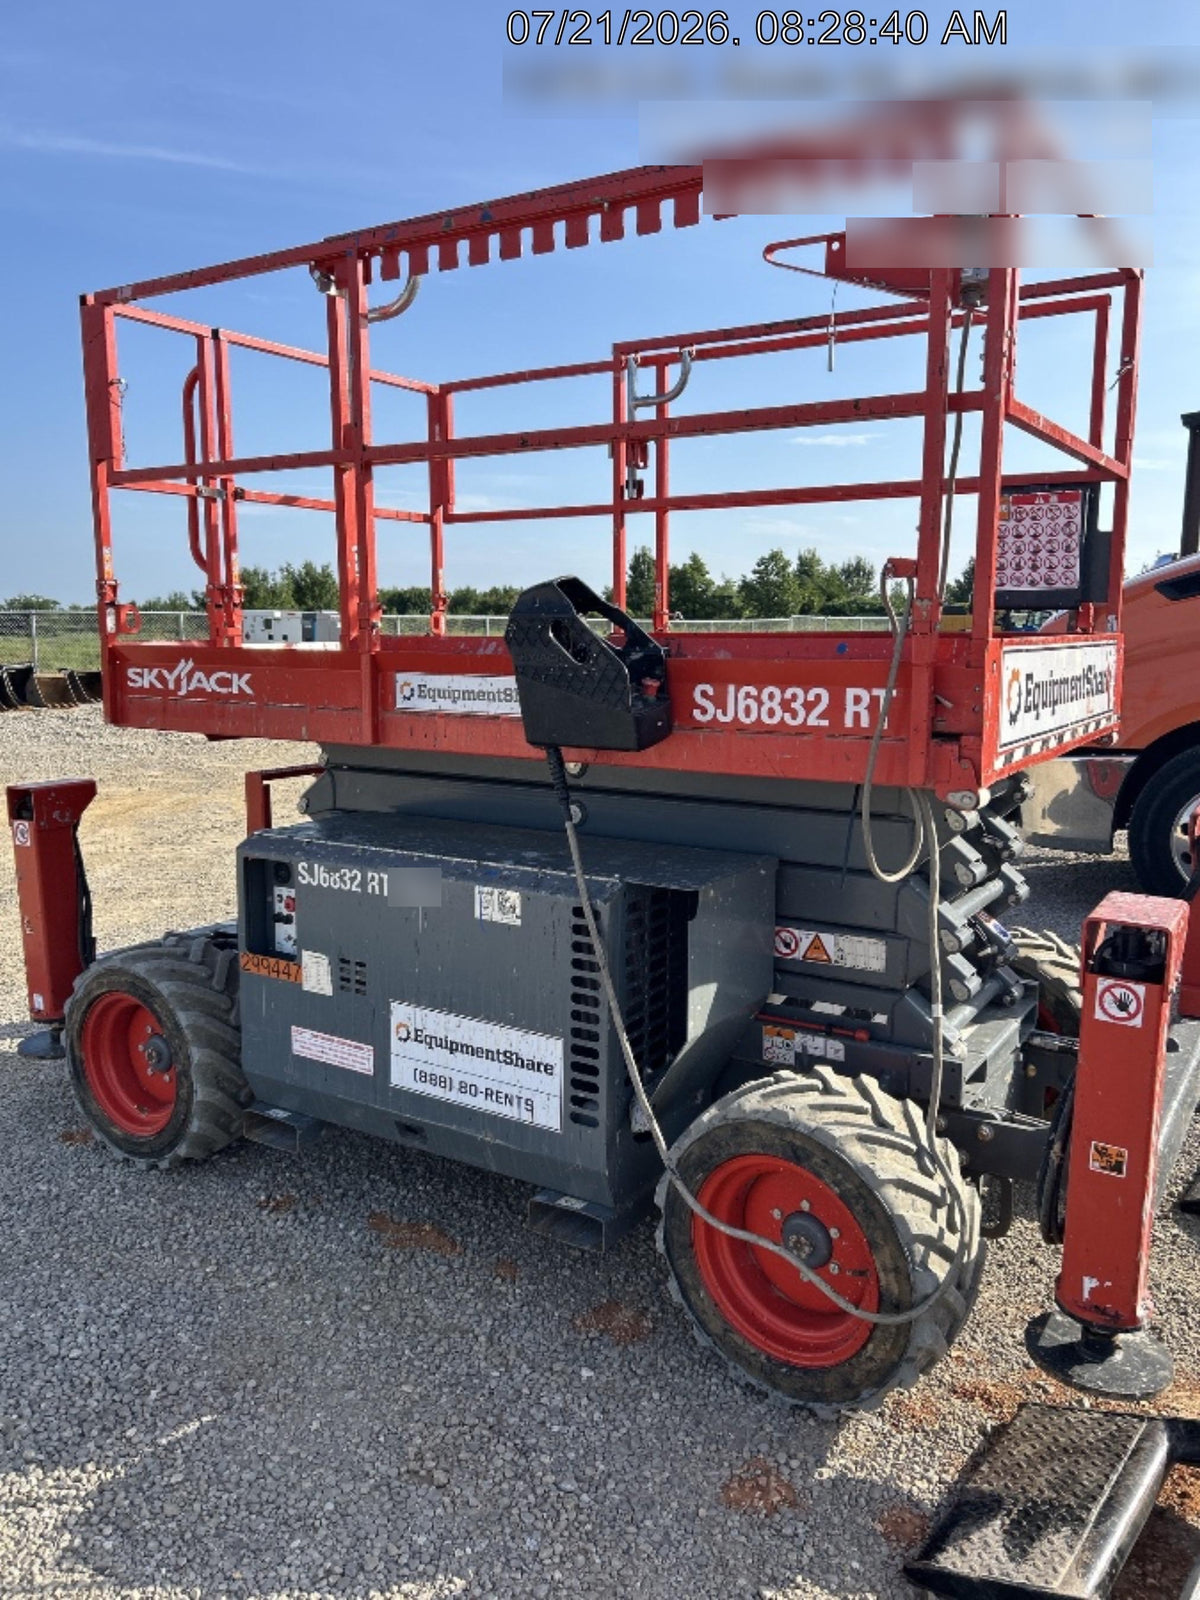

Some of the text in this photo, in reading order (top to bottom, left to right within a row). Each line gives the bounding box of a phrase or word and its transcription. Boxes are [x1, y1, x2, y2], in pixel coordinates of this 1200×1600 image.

[127, 658, 254, 695] SKYJACK
[692, 683, 897, 730] SJ6832 RT
[298, 861, 362, 893] SJ6832
[241, 953, 302, 983] 299447
[413, 1028, 555, 1077] EquipmentShare
[413, 1067, 453, 1092] (888)
